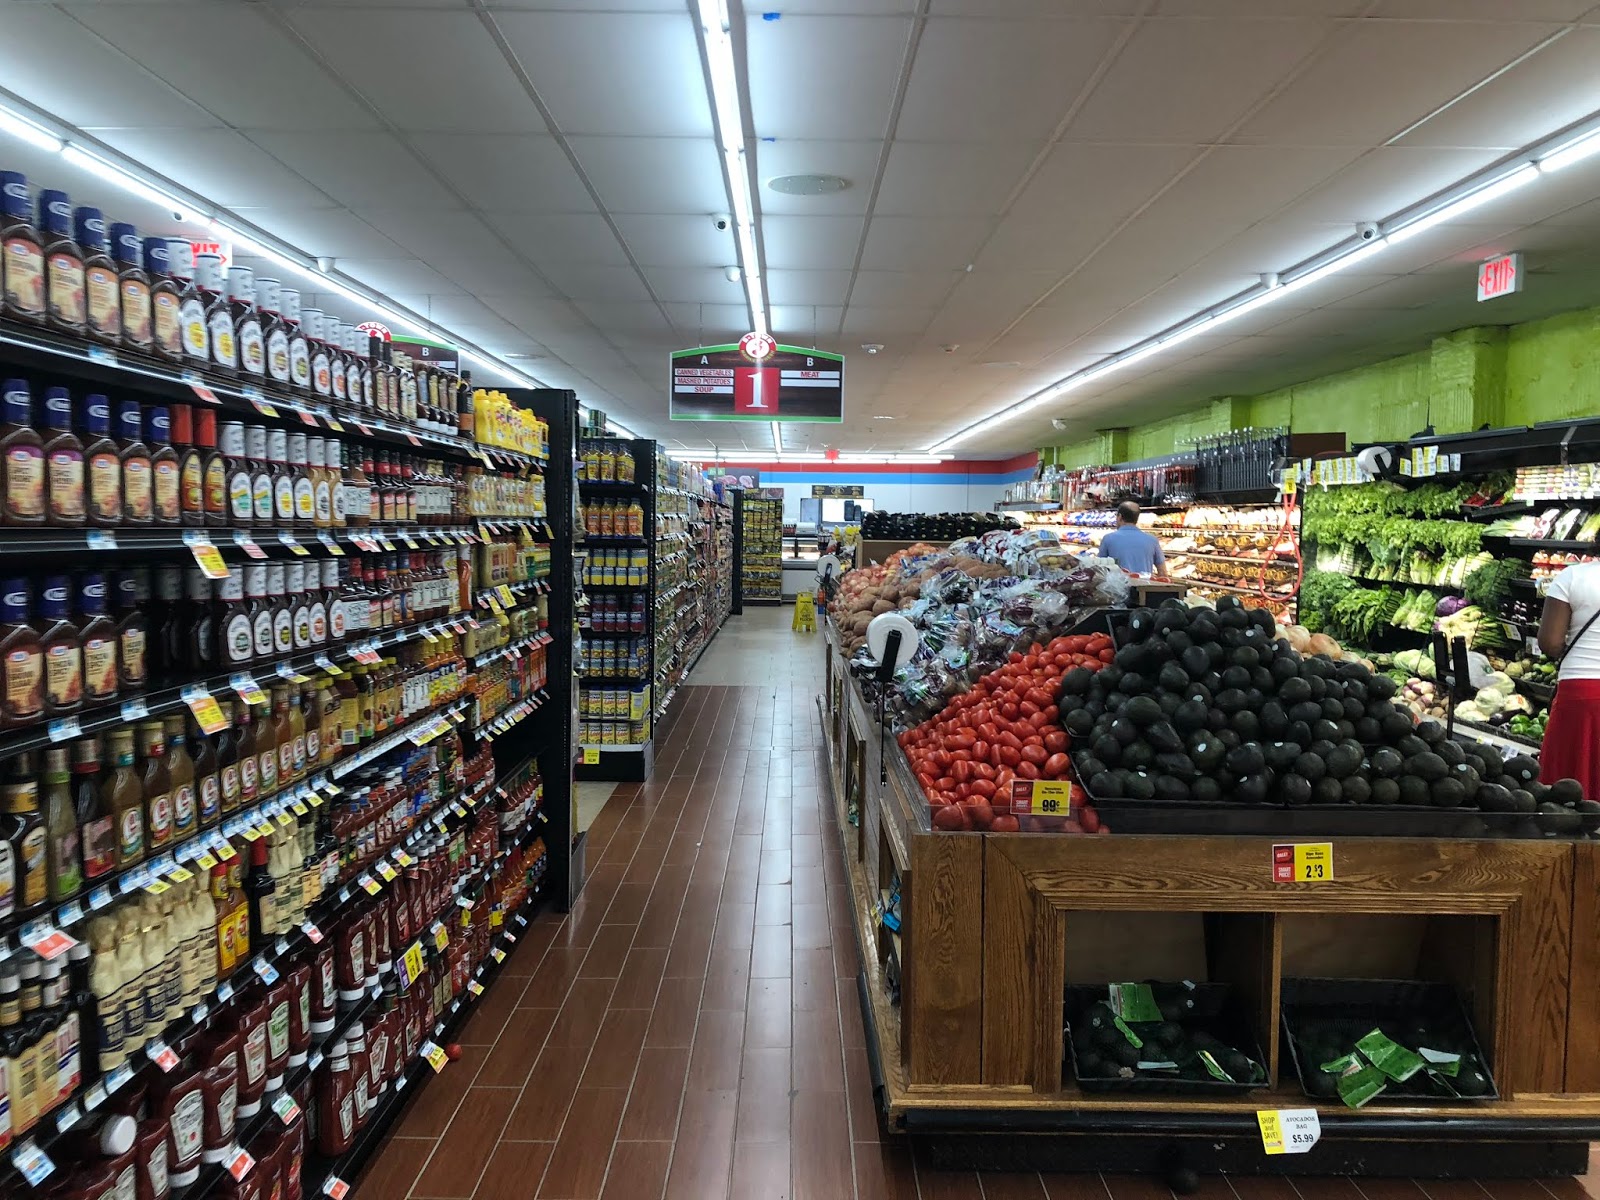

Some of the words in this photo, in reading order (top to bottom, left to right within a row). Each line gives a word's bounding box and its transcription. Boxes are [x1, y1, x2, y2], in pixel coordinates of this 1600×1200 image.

[1484, 257, 1511, 296] EXIT
[422, 347, 430, 356] B
[700, 355, 709, 365] A
[806, 358, 815, 367] B
[700, 369, 732, 377] VEGETABLES
[677, 377, 701, 385] MASHED
[745, 371, 769, 408] 1
[1260, 1117, 1275, 1125] SHOP
[1292, 1134, 1314, 1143] $5.99
